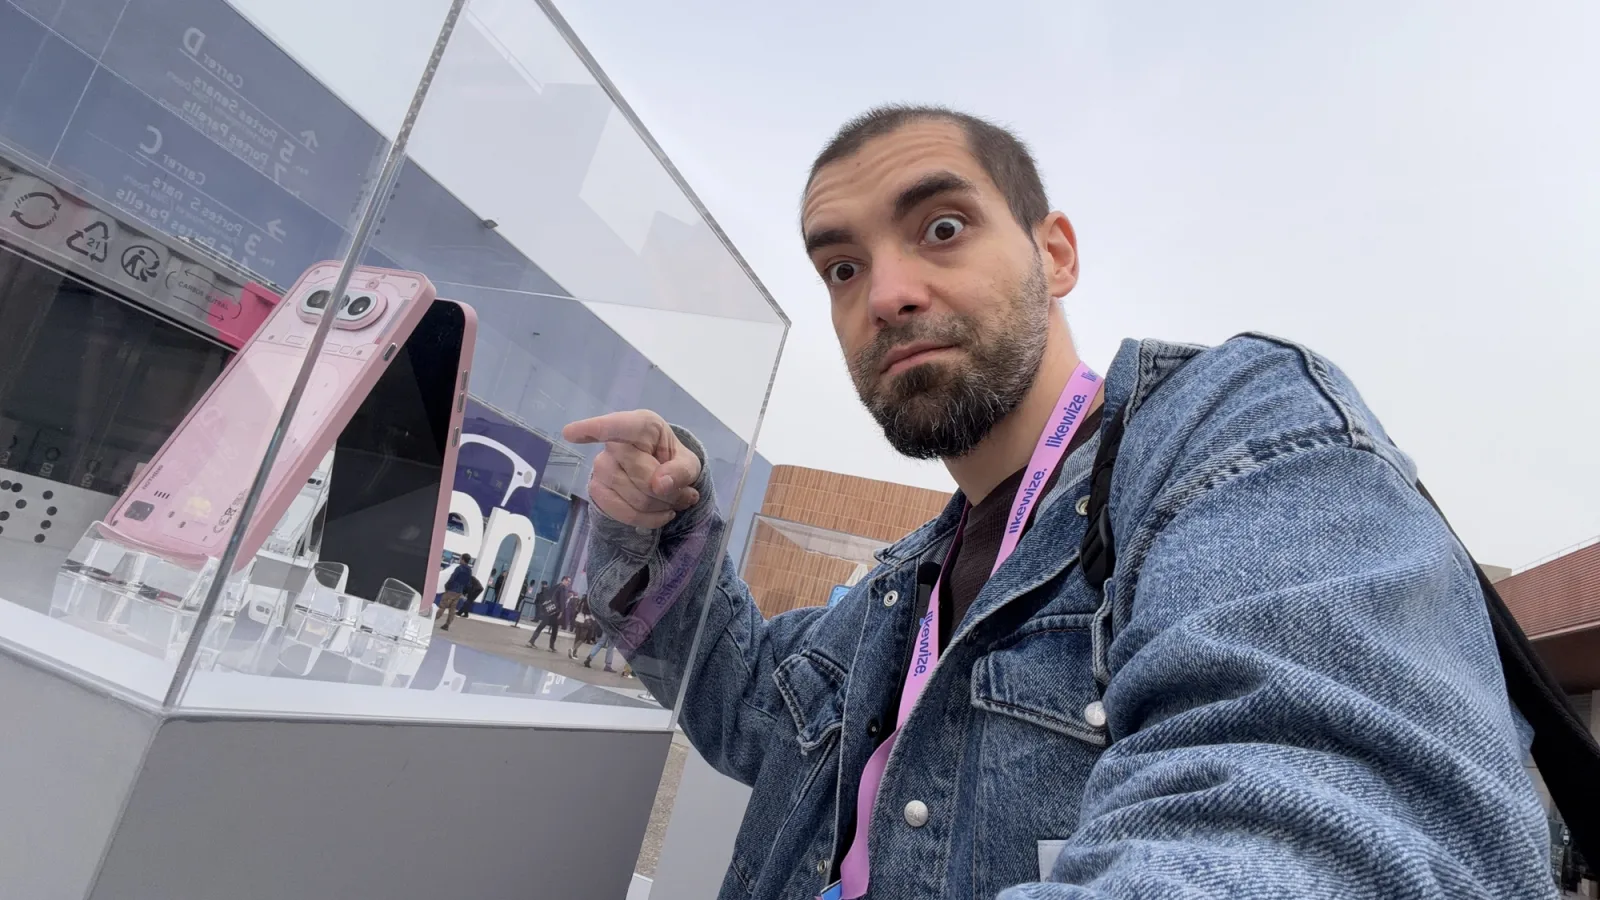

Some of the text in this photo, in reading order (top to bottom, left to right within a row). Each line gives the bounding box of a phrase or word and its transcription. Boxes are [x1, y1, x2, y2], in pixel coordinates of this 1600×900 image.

[1045, 394, 1088, 448] likewize.
[1008, 468, 1048, 534] likewize.
[914, 610, 934, 677] likewize.
